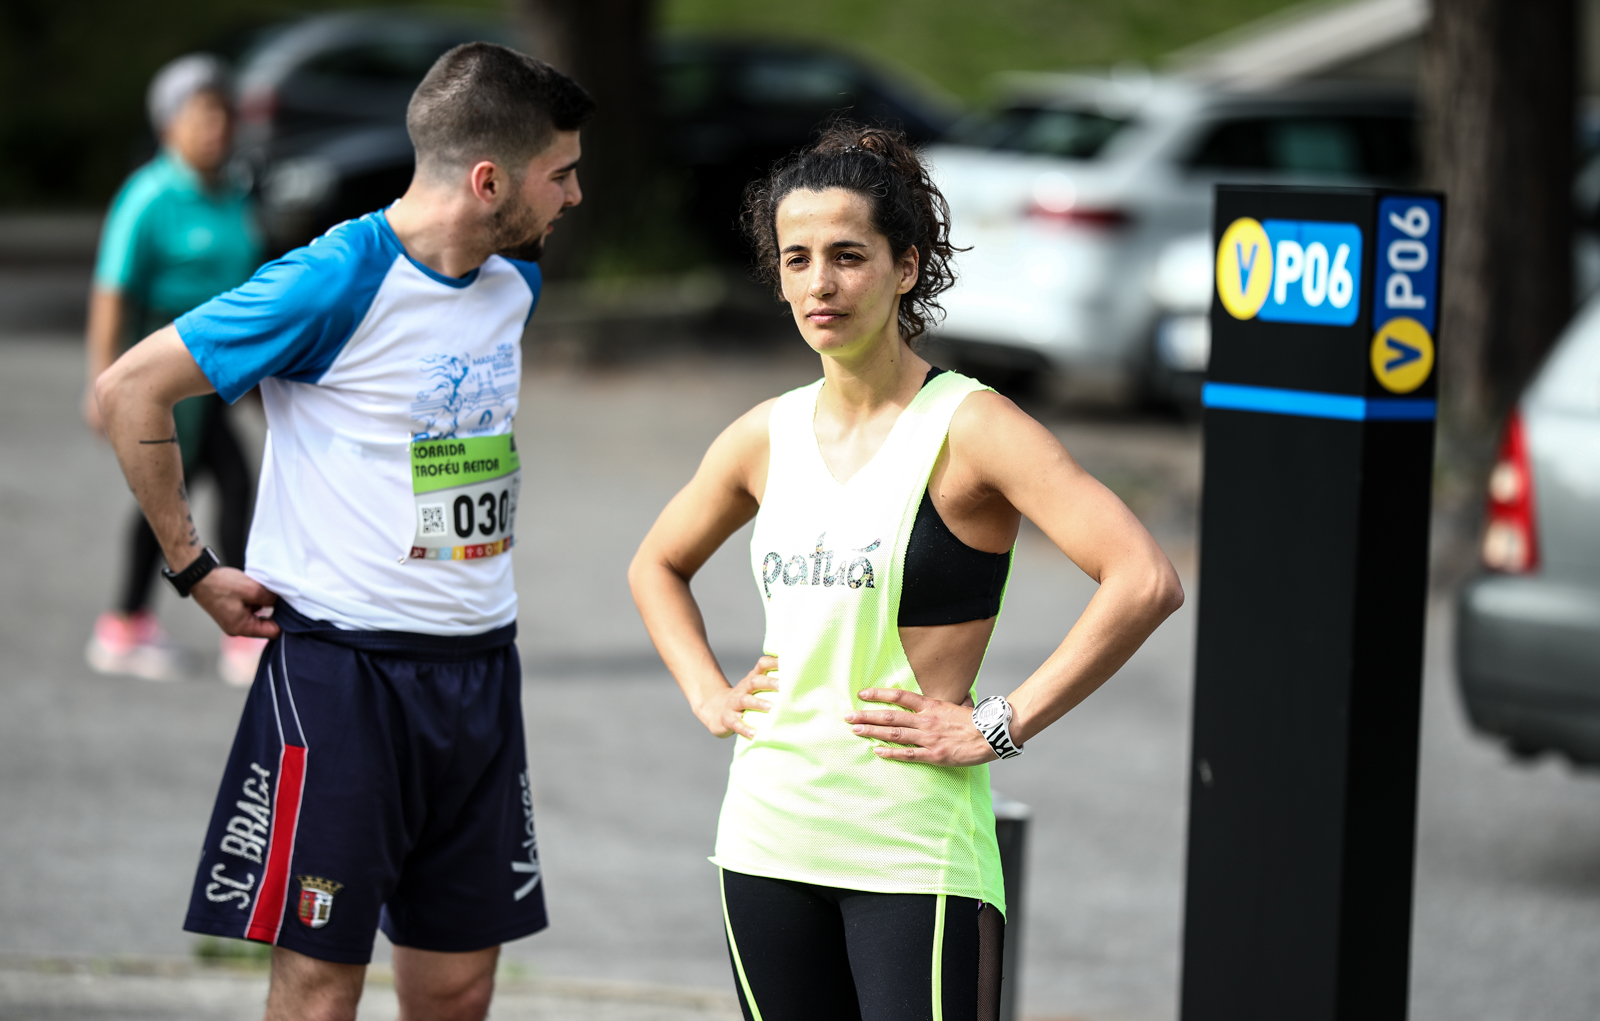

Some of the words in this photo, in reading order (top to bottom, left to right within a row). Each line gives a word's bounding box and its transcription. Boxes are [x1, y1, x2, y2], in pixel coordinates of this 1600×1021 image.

[1274, 240, 1354, 309] P06
[1385, 205, 1431, 310] P06
[413, 443, 466, 459] CORRIDA
[415, 459, 460, 477] TROFÉU
[463, 458, 500, 473] REITOR
[453, 489, 509, 538] 030
[205, 862, 255, 910] SC
